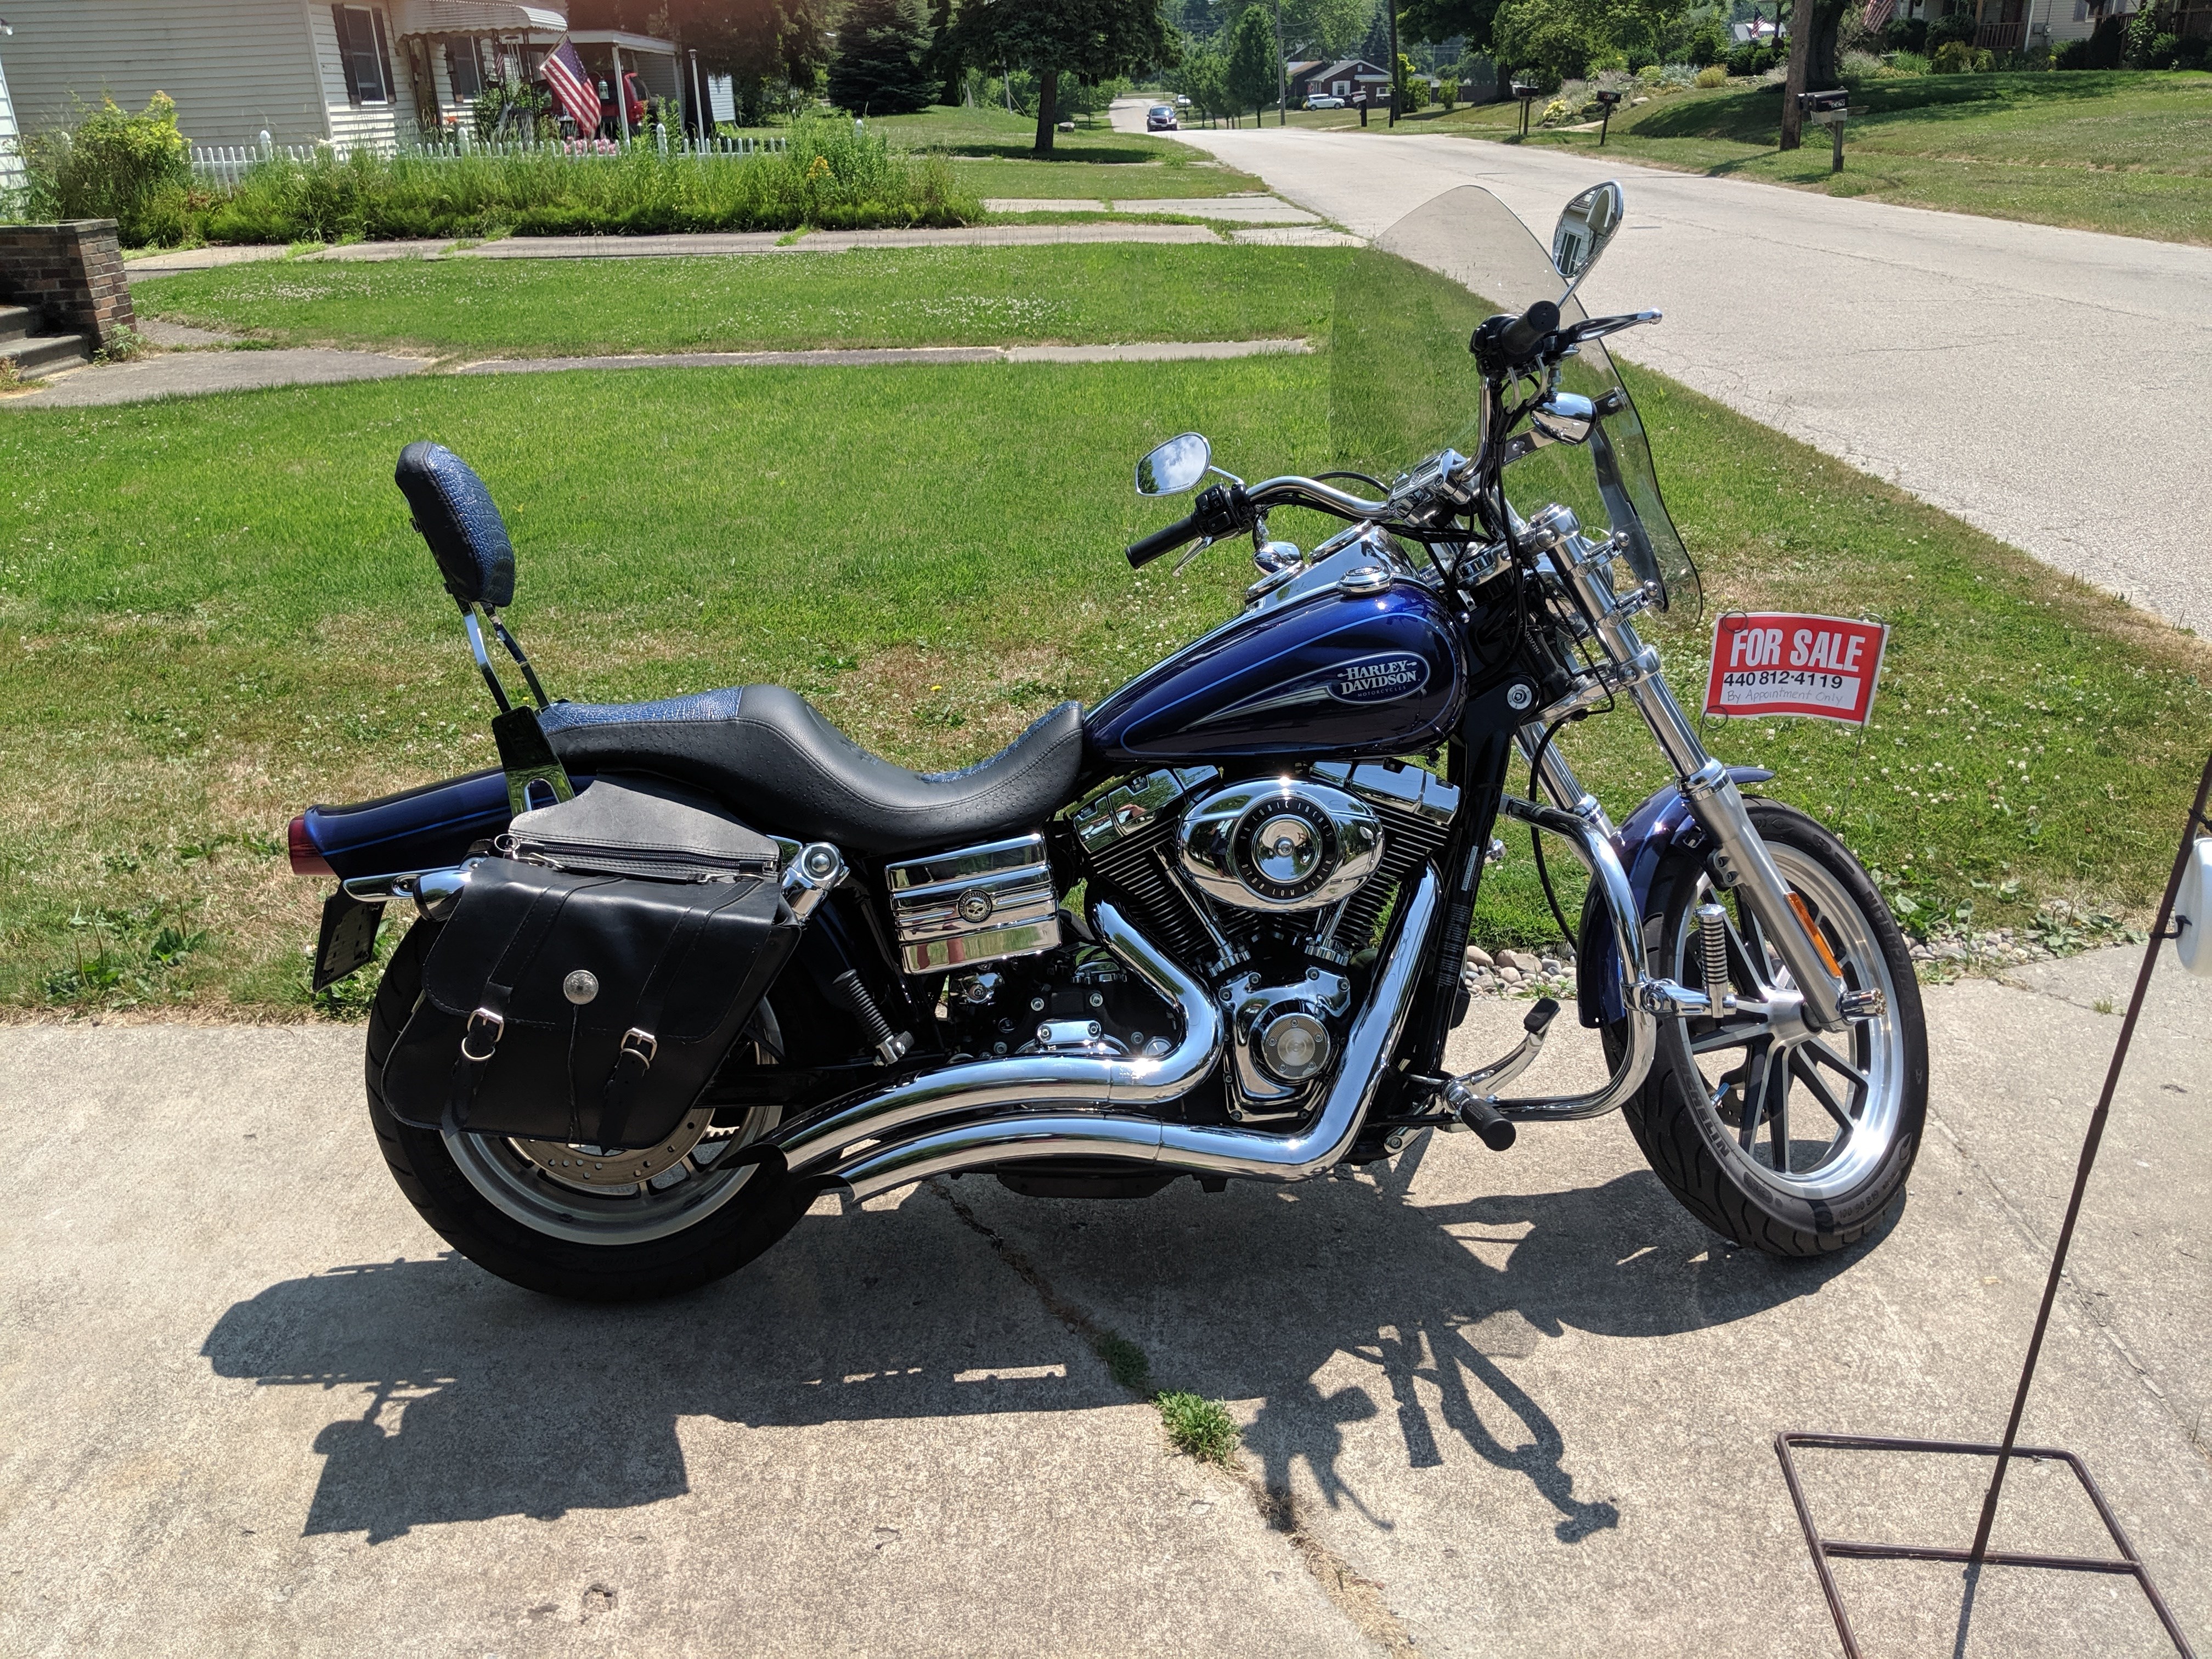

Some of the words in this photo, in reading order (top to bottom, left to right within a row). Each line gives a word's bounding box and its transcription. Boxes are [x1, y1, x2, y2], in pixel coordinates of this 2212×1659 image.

[1832, 99, 1844, 108] 229
[1729, 628, 1784, 667] FOR
[1790, 629, 1865, 673] SALE
[1343, 660, 1412, 681] HARLEY
[1723, 672, 1756, 687] 440
[1340, 670, 1417, 695] DAVIDSON
[1357, 686, 1407, 697] MOTORCYCLES
[1726, 690, 1741, 704] By
[1745, 687, 1812, 702] Appointment
[1815, 691, 1843, 707] Only
[1240, 827, 1250, 840] 96
[1252, 801, 1289, 821] CUBIC
[1298, 803, 1333, 837] INCHES
[1303, 859, 1334, 891] RIDER
